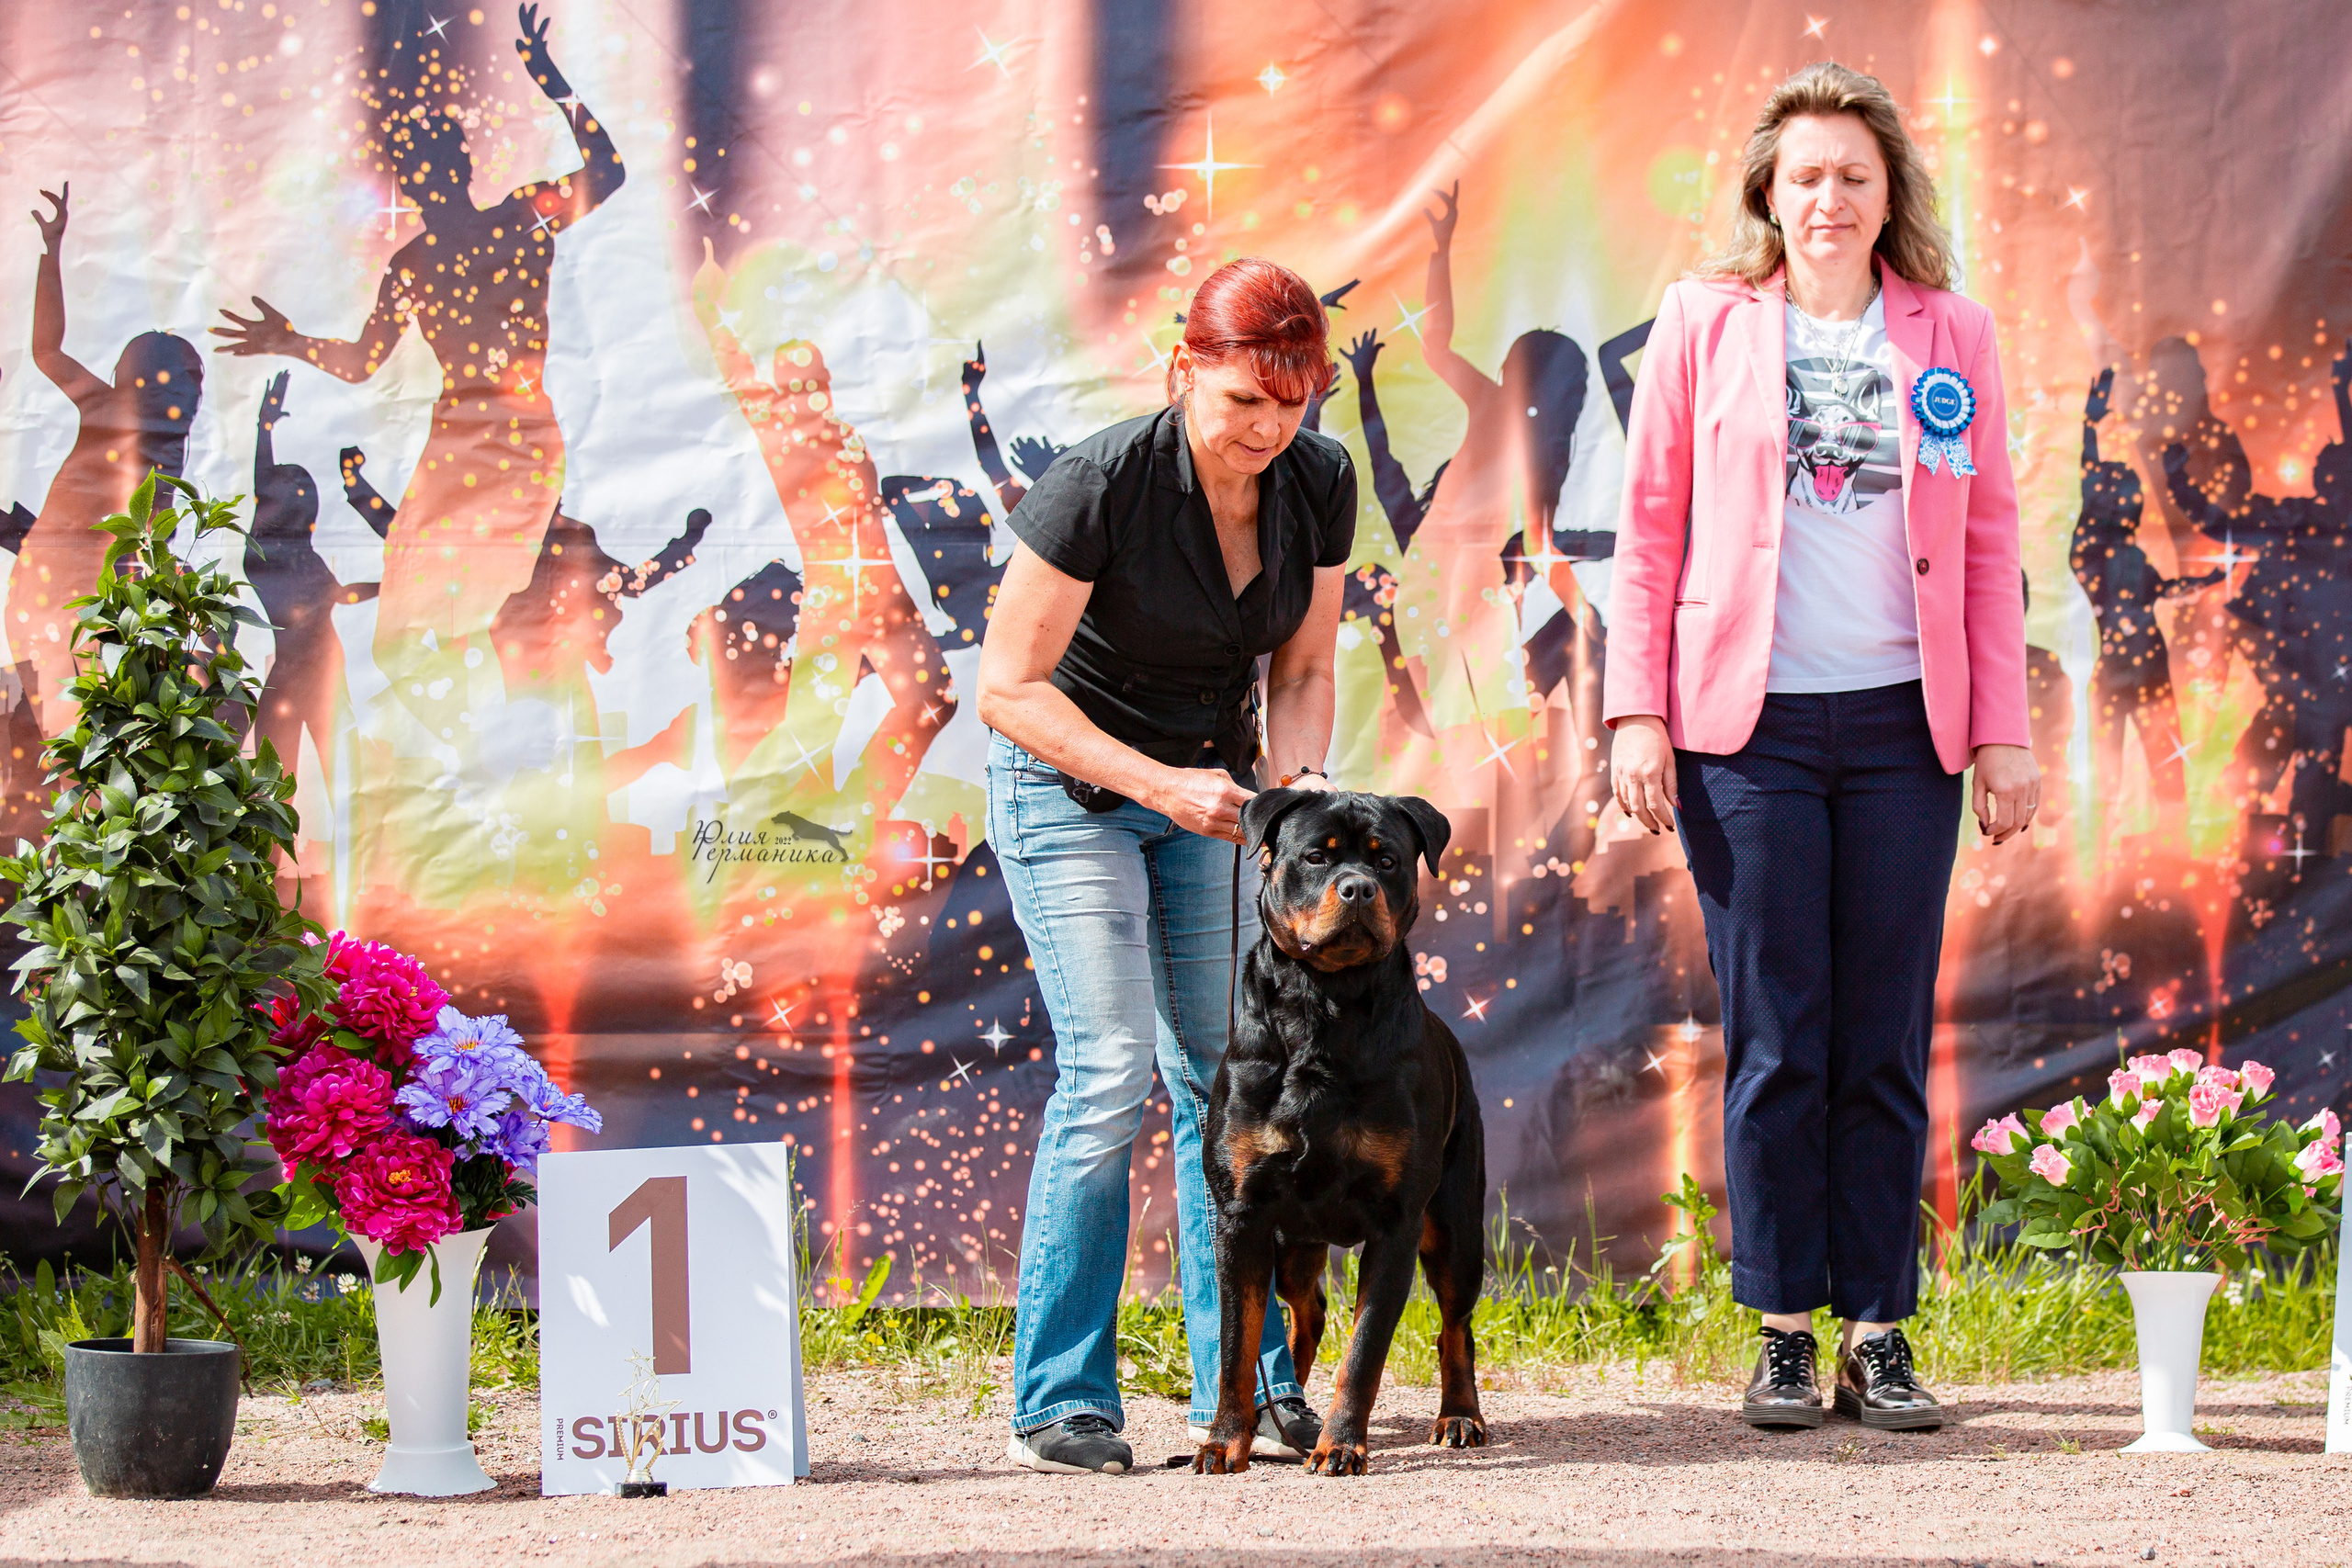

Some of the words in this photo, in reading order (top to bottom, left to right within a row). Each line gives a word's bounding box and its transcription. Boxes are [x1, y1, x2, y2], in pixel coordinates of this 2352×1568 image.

[1934, 396, 1956, 405] JUDGE
[608, 1175, 691, 1375] 1
[556, 1417, 565, 1461] PREMIUM
